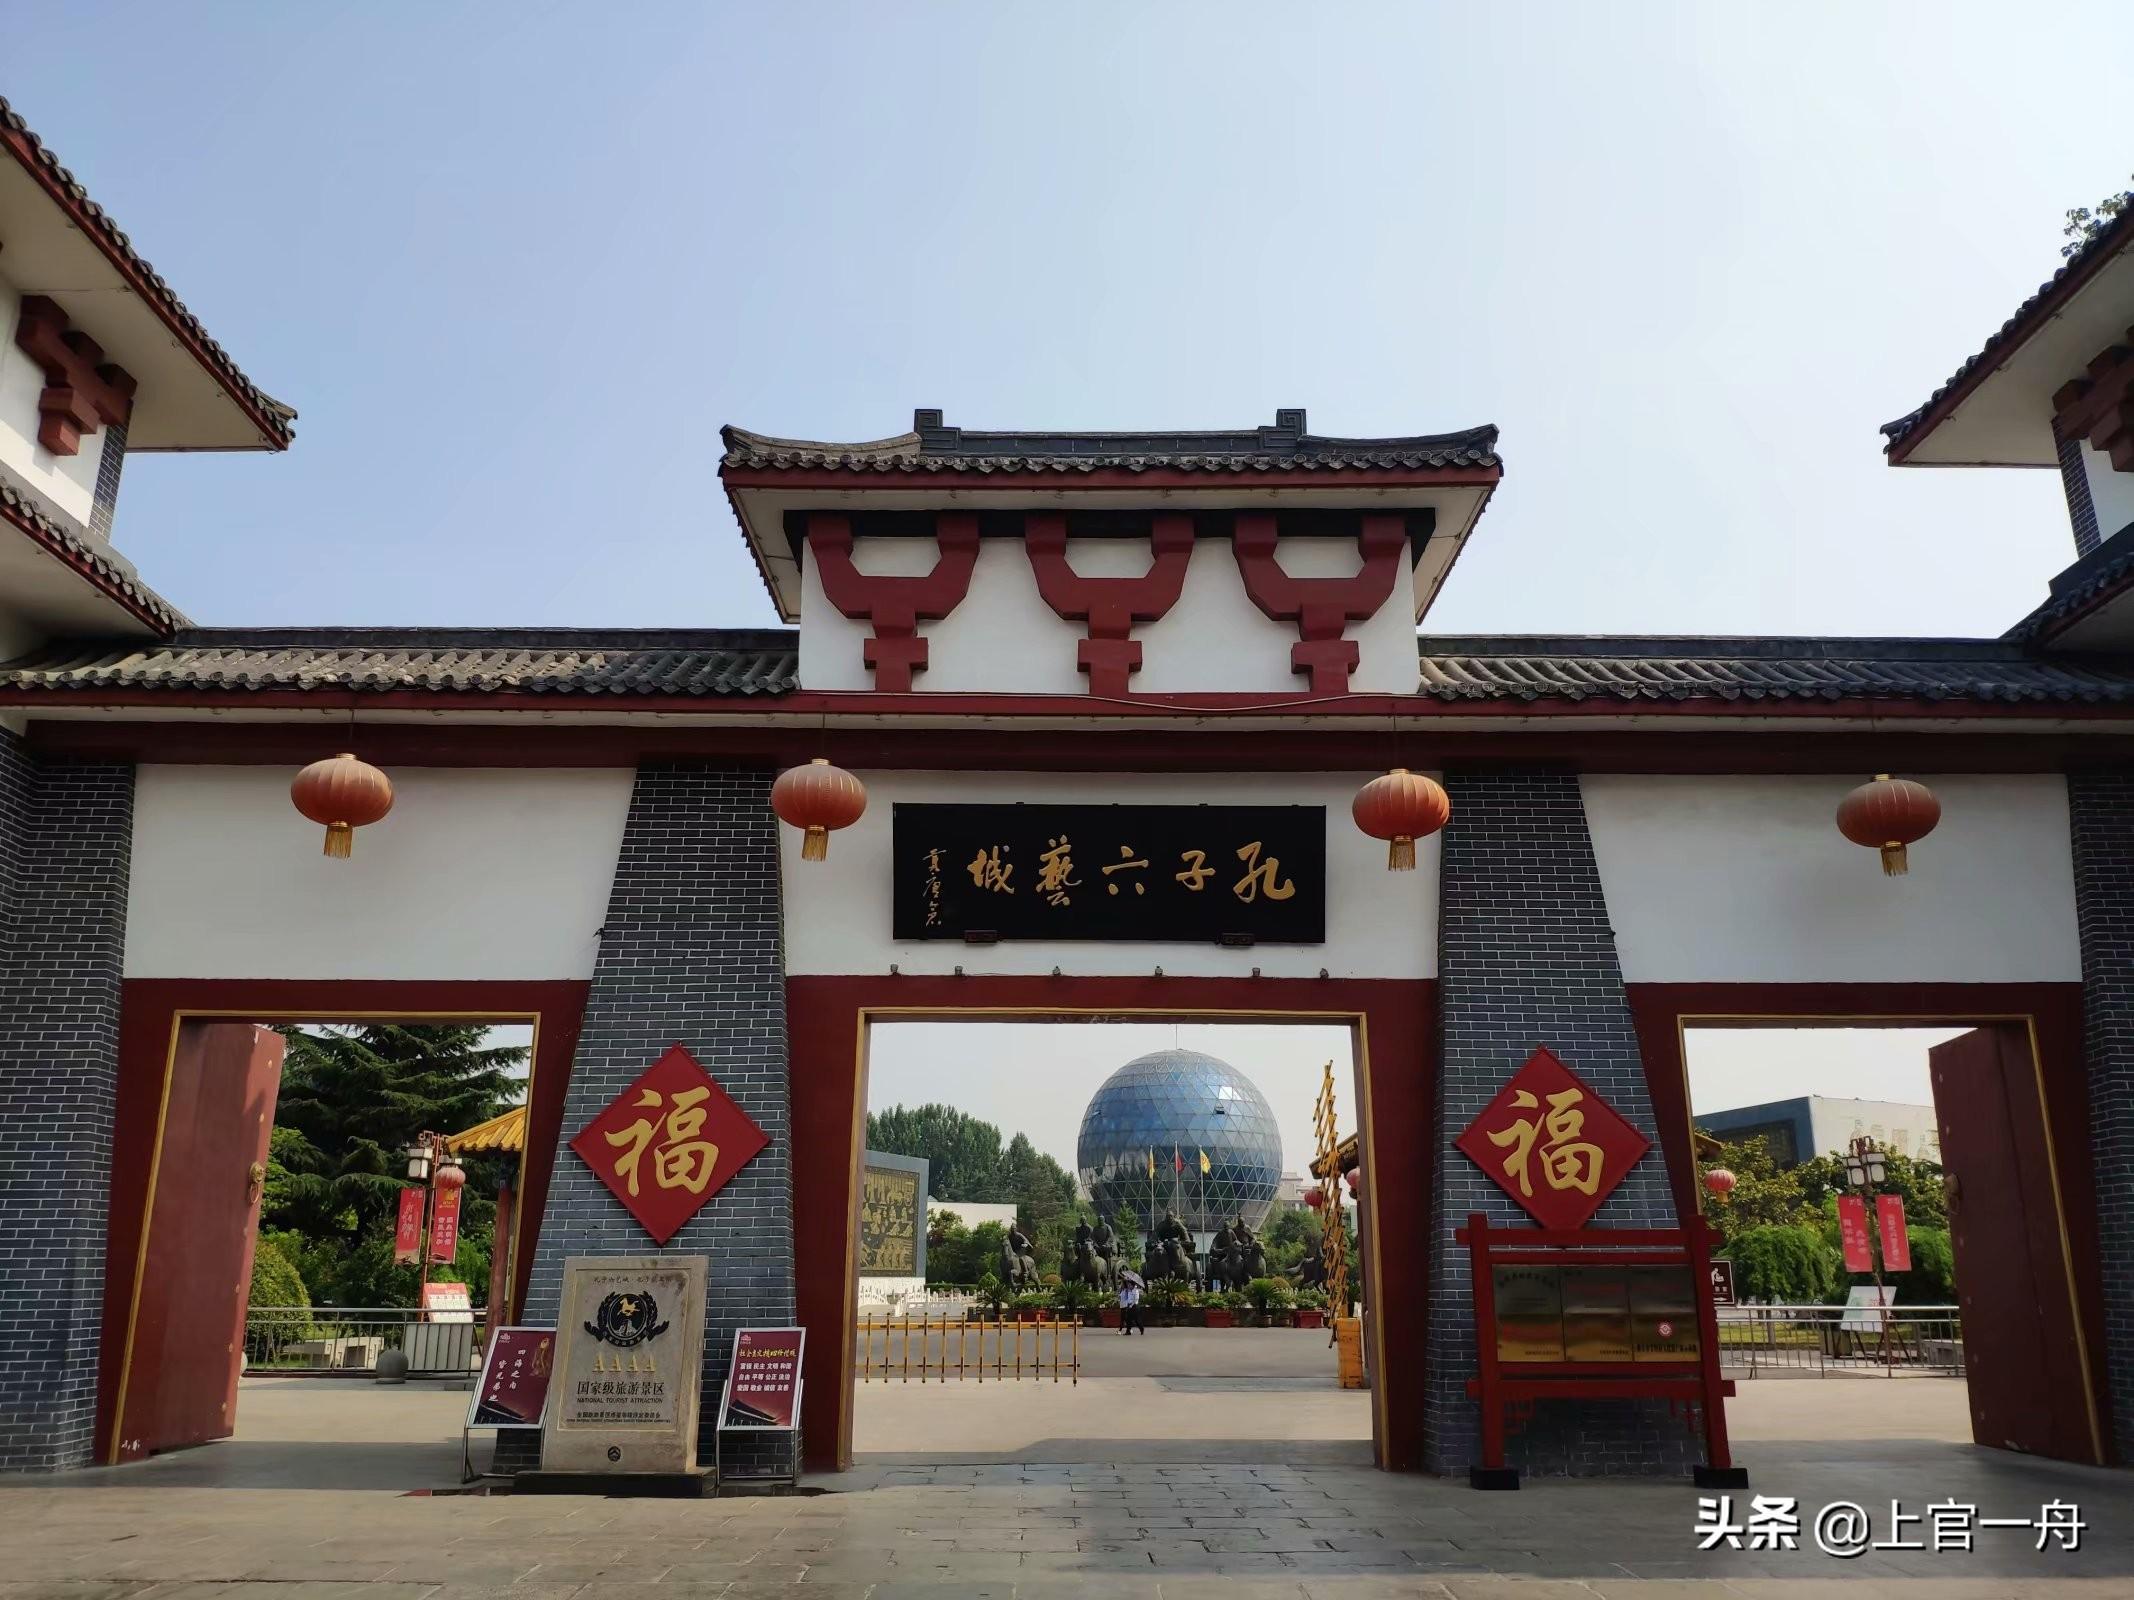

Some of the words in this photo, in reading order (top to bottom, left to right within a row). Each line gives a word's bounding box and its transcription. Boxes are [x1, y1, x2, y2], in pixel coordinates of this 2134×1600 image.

[604, 1086, 719, 1198] 福
[1486, 1087, 1605, 1198] 福
[487, 1359, 508, 1402] 皆兄弟也
[508, 1349, 527, 1391] 四海之内
[576, 1380, 665, 1396] 国家级旅游景区
